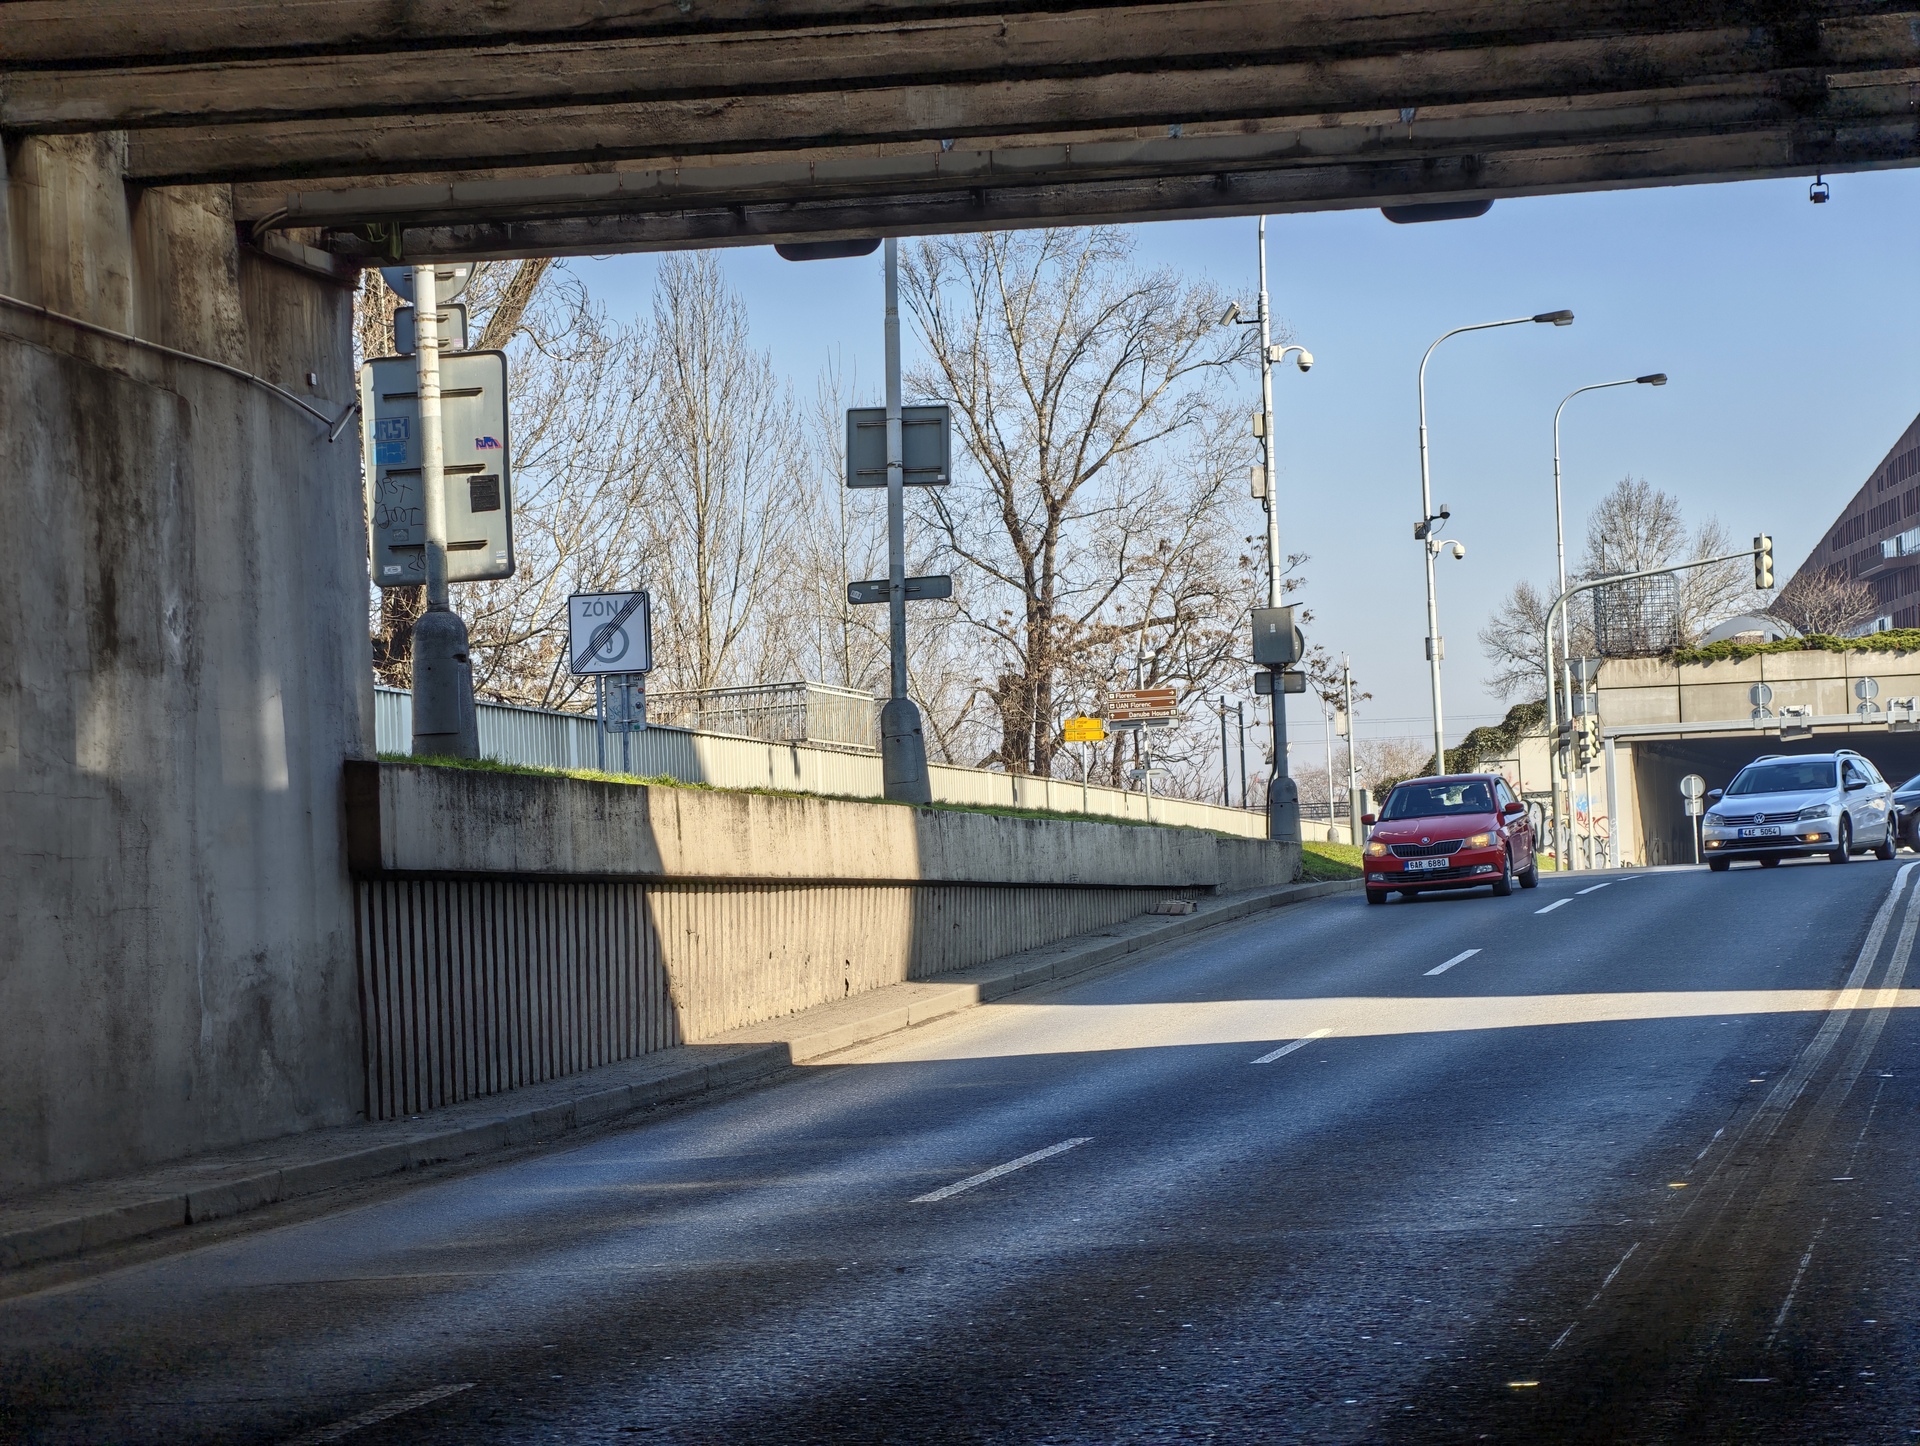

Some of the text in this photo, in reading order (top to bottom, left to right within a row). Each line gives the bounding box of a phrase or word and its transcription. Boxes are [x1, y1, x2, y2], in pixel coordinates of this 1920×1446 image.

[1760, 827, 1777, 835] 5054
[1410, 859, 1446, 869] 6AR 6880
